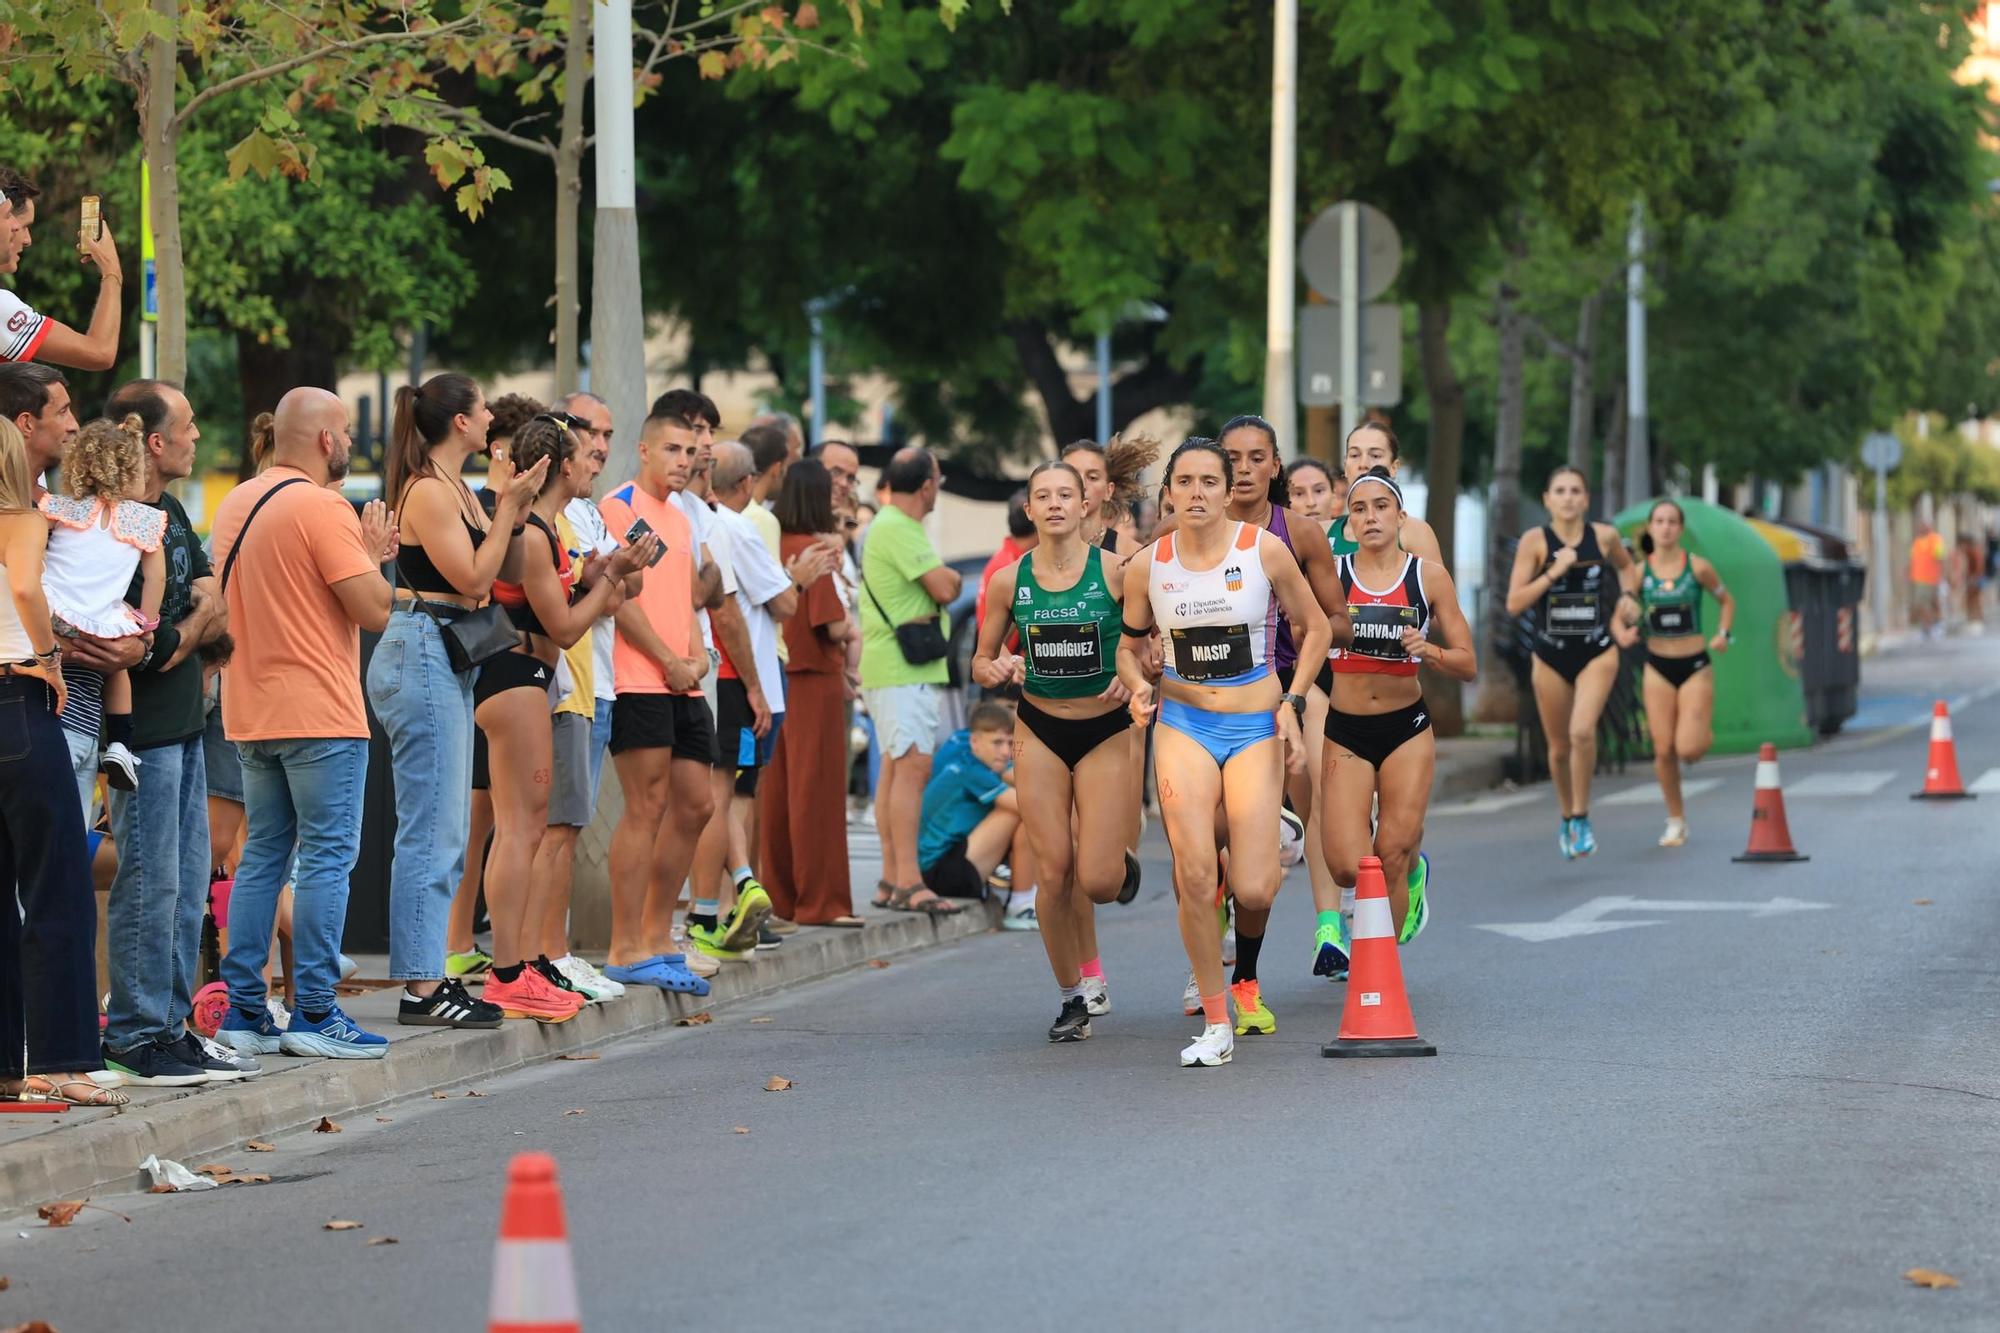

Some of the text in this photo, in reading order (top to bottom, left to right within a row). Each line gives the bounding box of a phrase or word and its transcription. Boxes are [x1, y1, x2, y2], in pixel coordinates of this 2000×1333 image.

[1193, 598, 1226, 608] Diputació
[1193, 608, 1202, 616] de
[1034, 638, 1095, 658] RODRÍGUEZ
[1191, 643, 1232, 662] MASIP
